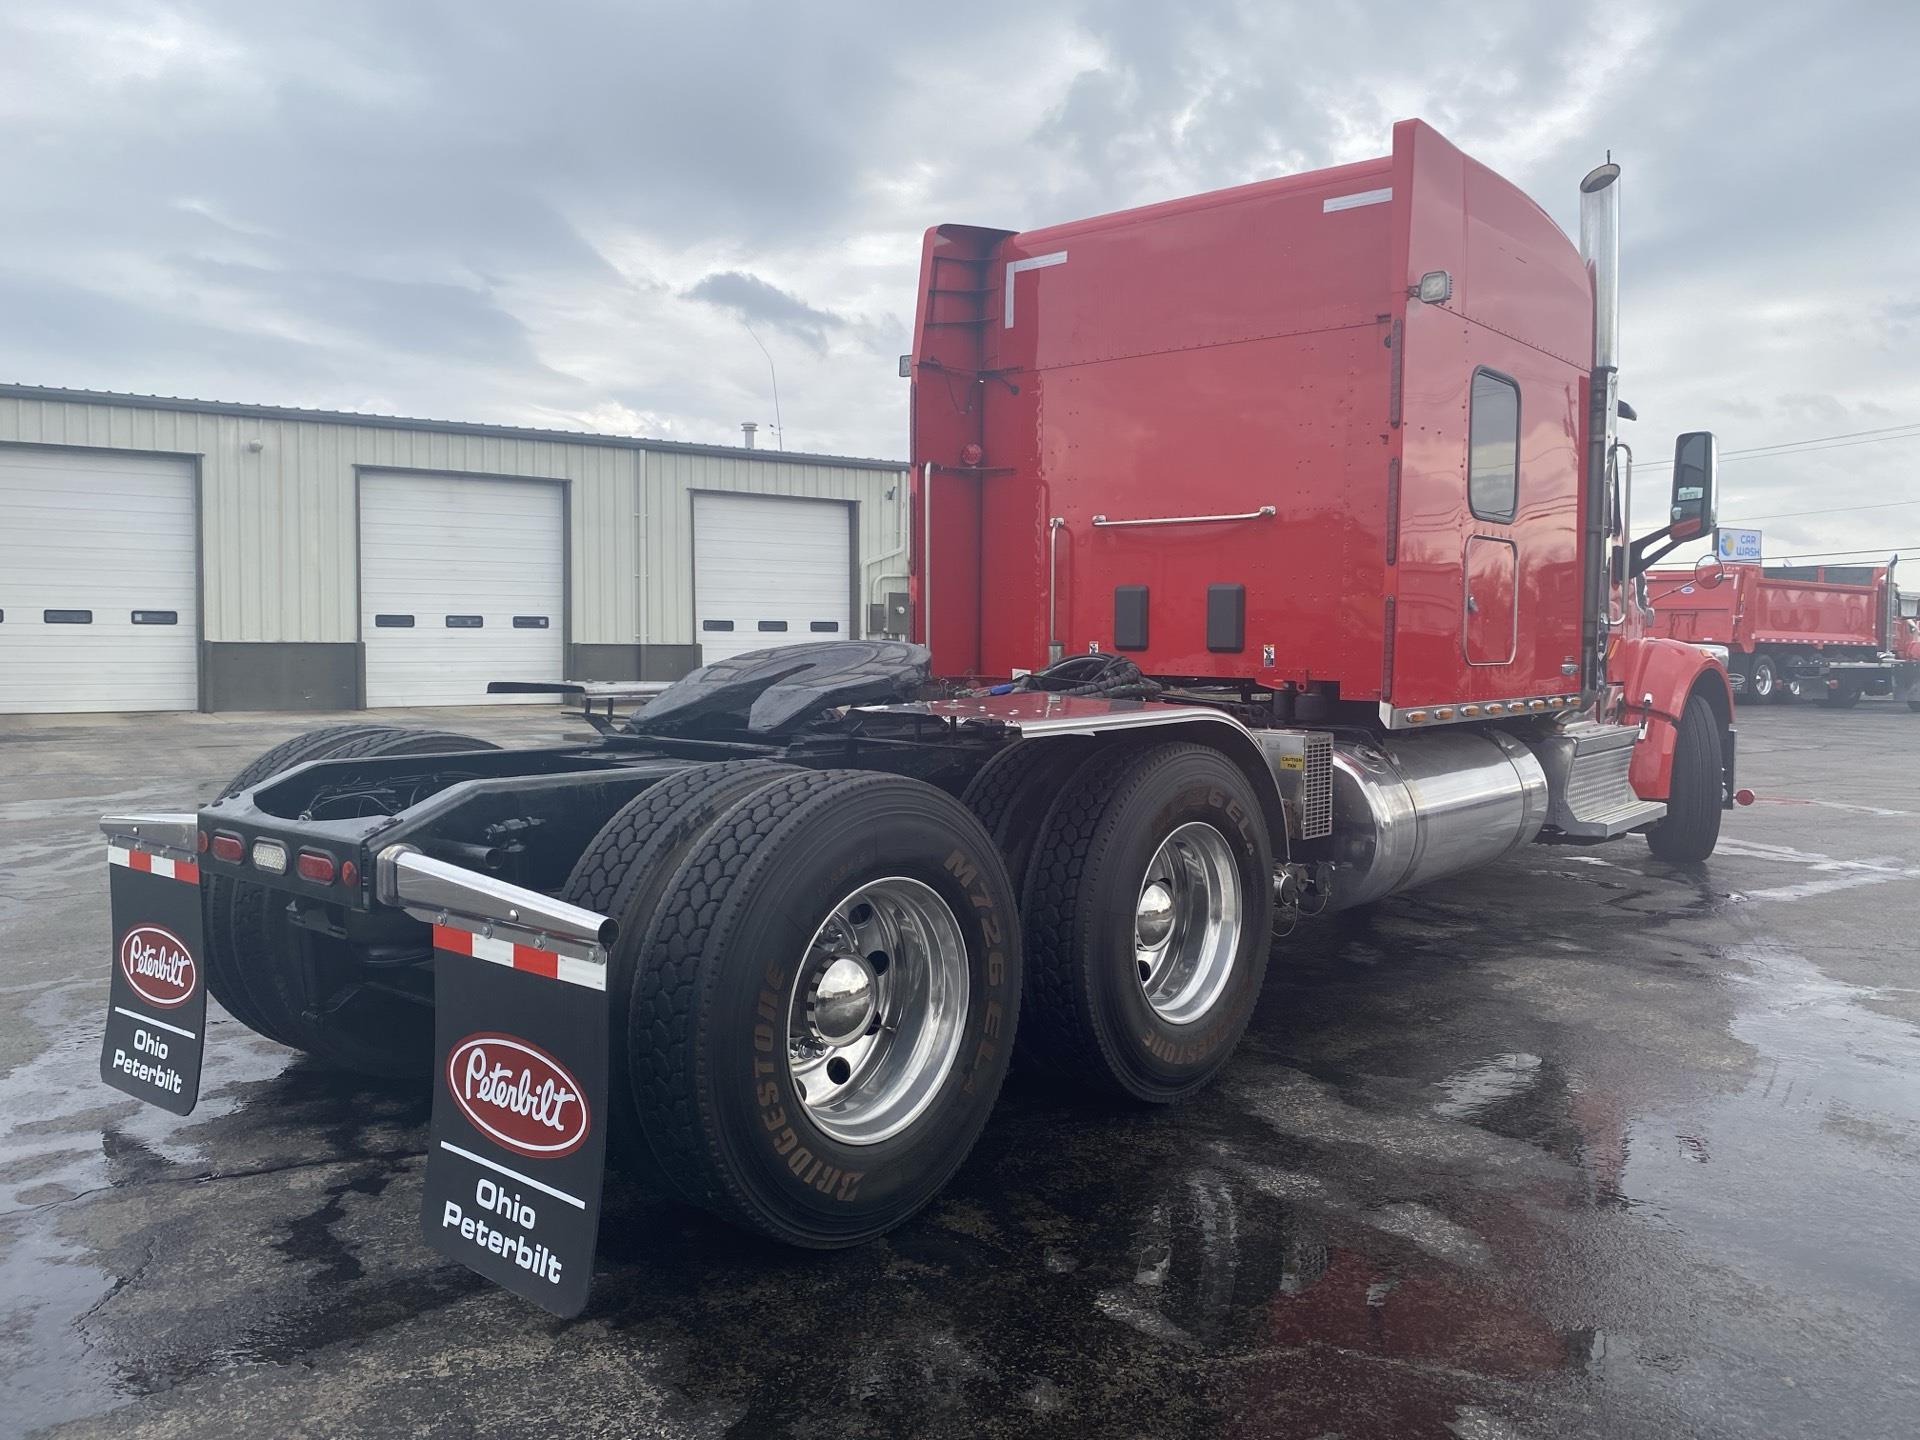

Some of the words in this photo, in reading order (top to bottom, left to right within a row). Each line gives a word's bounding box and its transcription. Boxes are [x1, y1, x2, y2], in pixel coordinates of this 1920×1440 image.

[1736, 546, 1760, 557] WASH
[1740, 534, 1756, 545] CAR
[943, 848, 1005, 986] M726
[129, 934, 191, 988] Peterbilt
[113, 1048, 183, 1094] Peterbilt
[133, 1029, 169, 1060] Ohio
[465, 1047, 577, 1131] Peterbilt
[753, 958, 866, 1202] BRIDGESTONE
[475, 1178, 536, 1230] Ohio
[442, 1200, 563, 1285] Peterbilt
